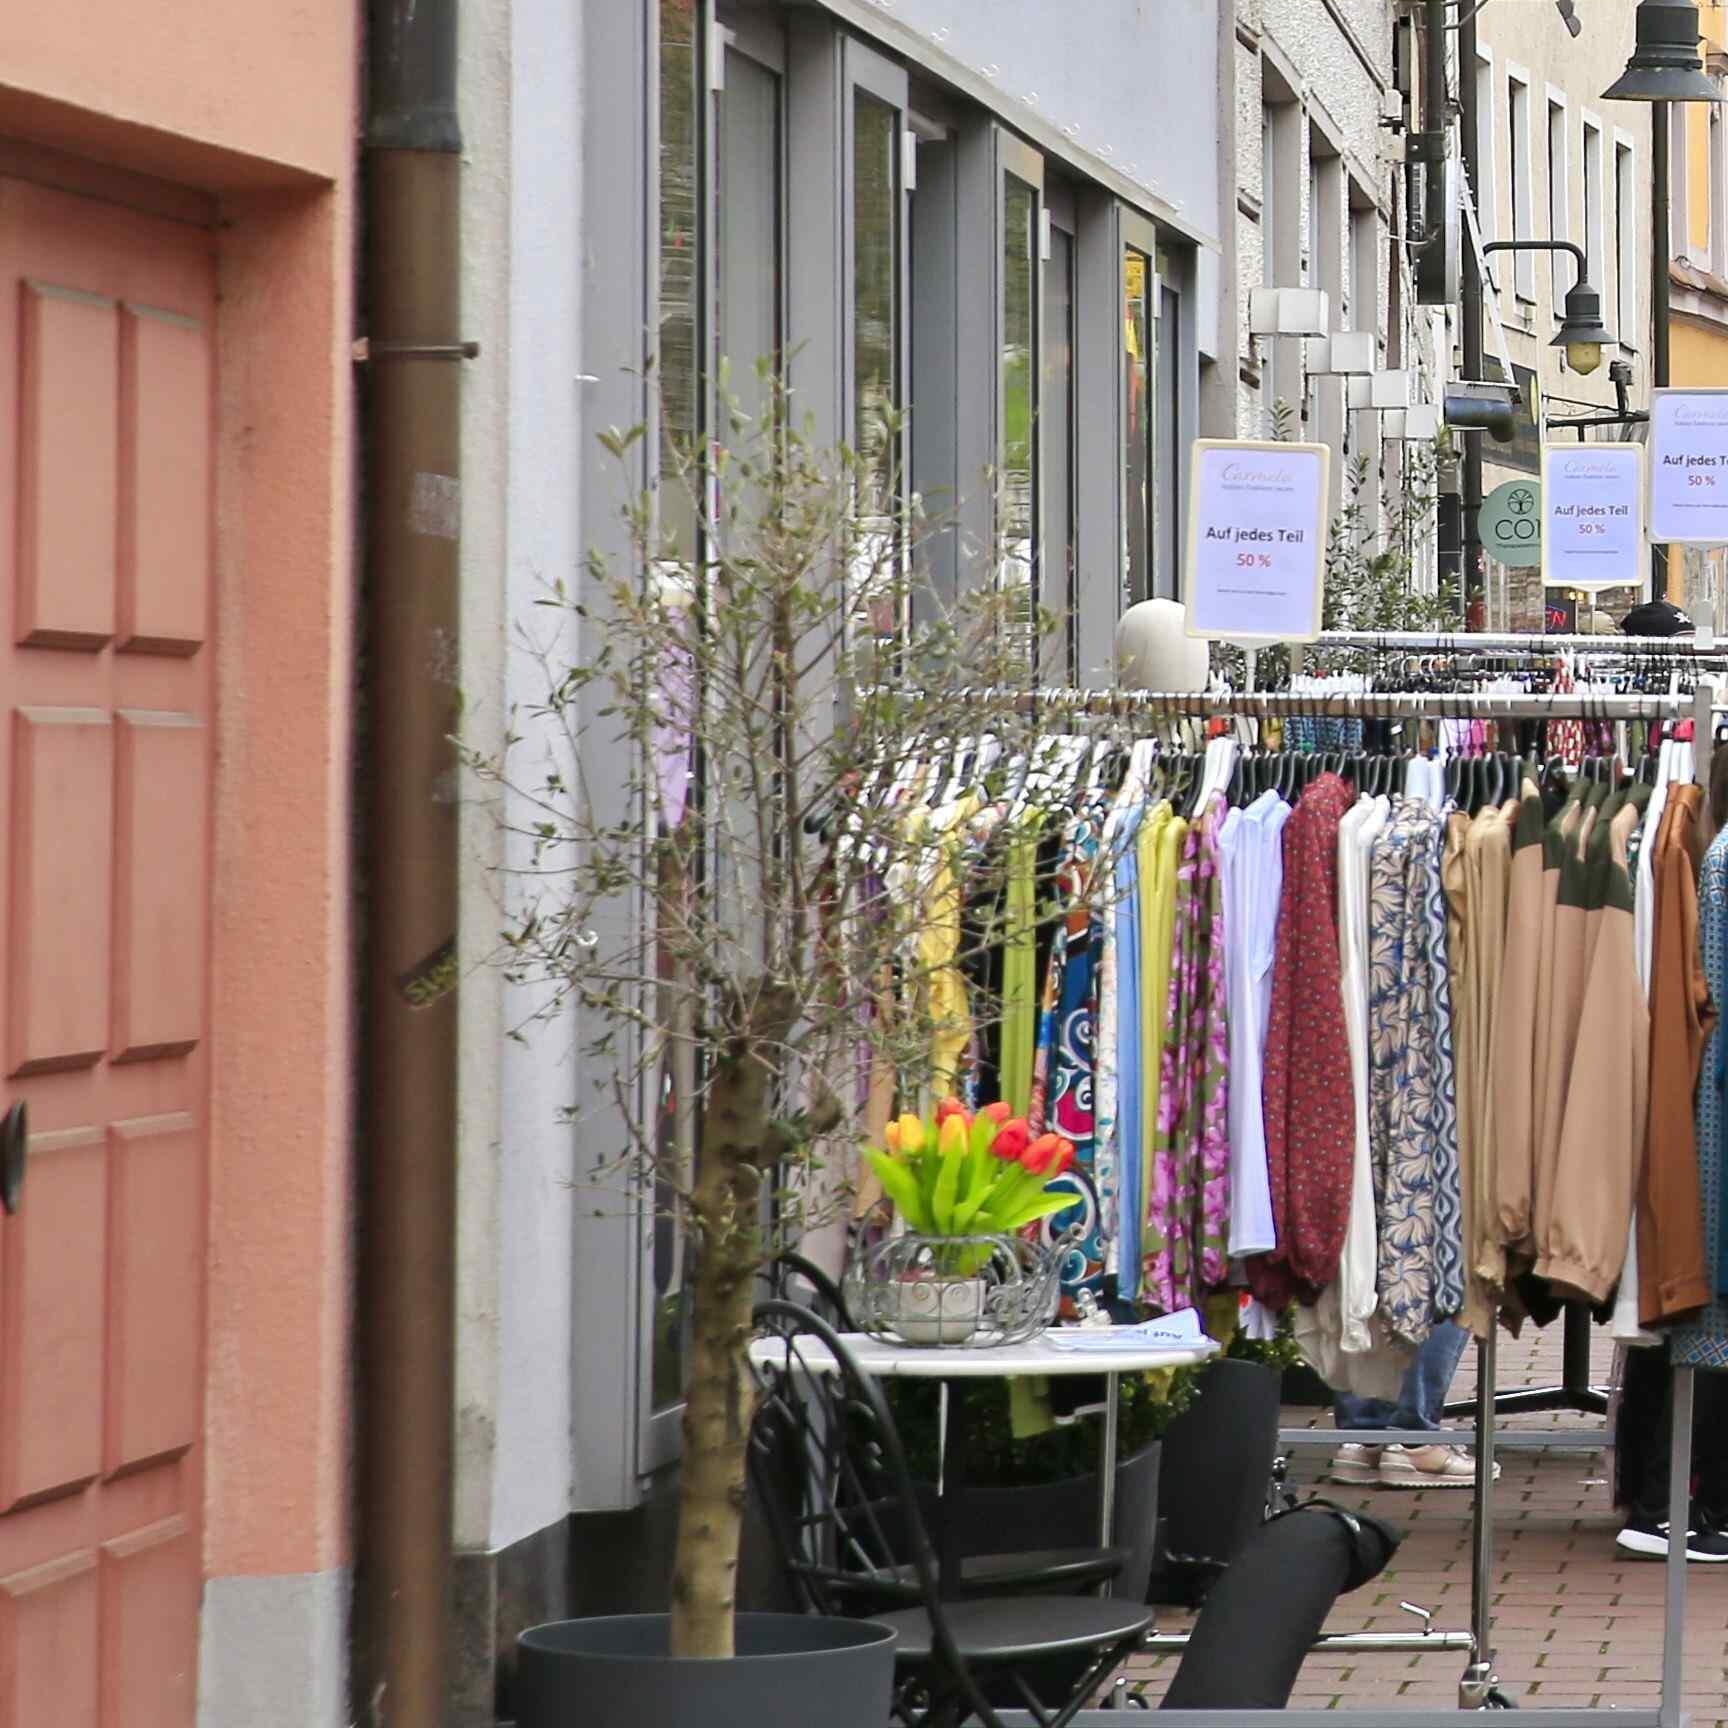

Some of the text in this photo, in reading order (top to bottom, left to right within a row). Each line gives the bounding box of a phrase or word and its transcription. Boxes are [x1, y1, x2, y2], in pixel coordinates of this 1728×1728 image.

[1662, 454, 1684, 466] Auf
[1685, 455, 1717, 468] jedes
[1688, 475, 1716, 487] 50 %
[1554, 505, 1629, 518] Auf jedes Teil
[1205, 526, 1305, 543] Auf jedes Teil
[1578, 523, 1606, 535] 50 %
[1236, 553, 1272, 568] 50 %
